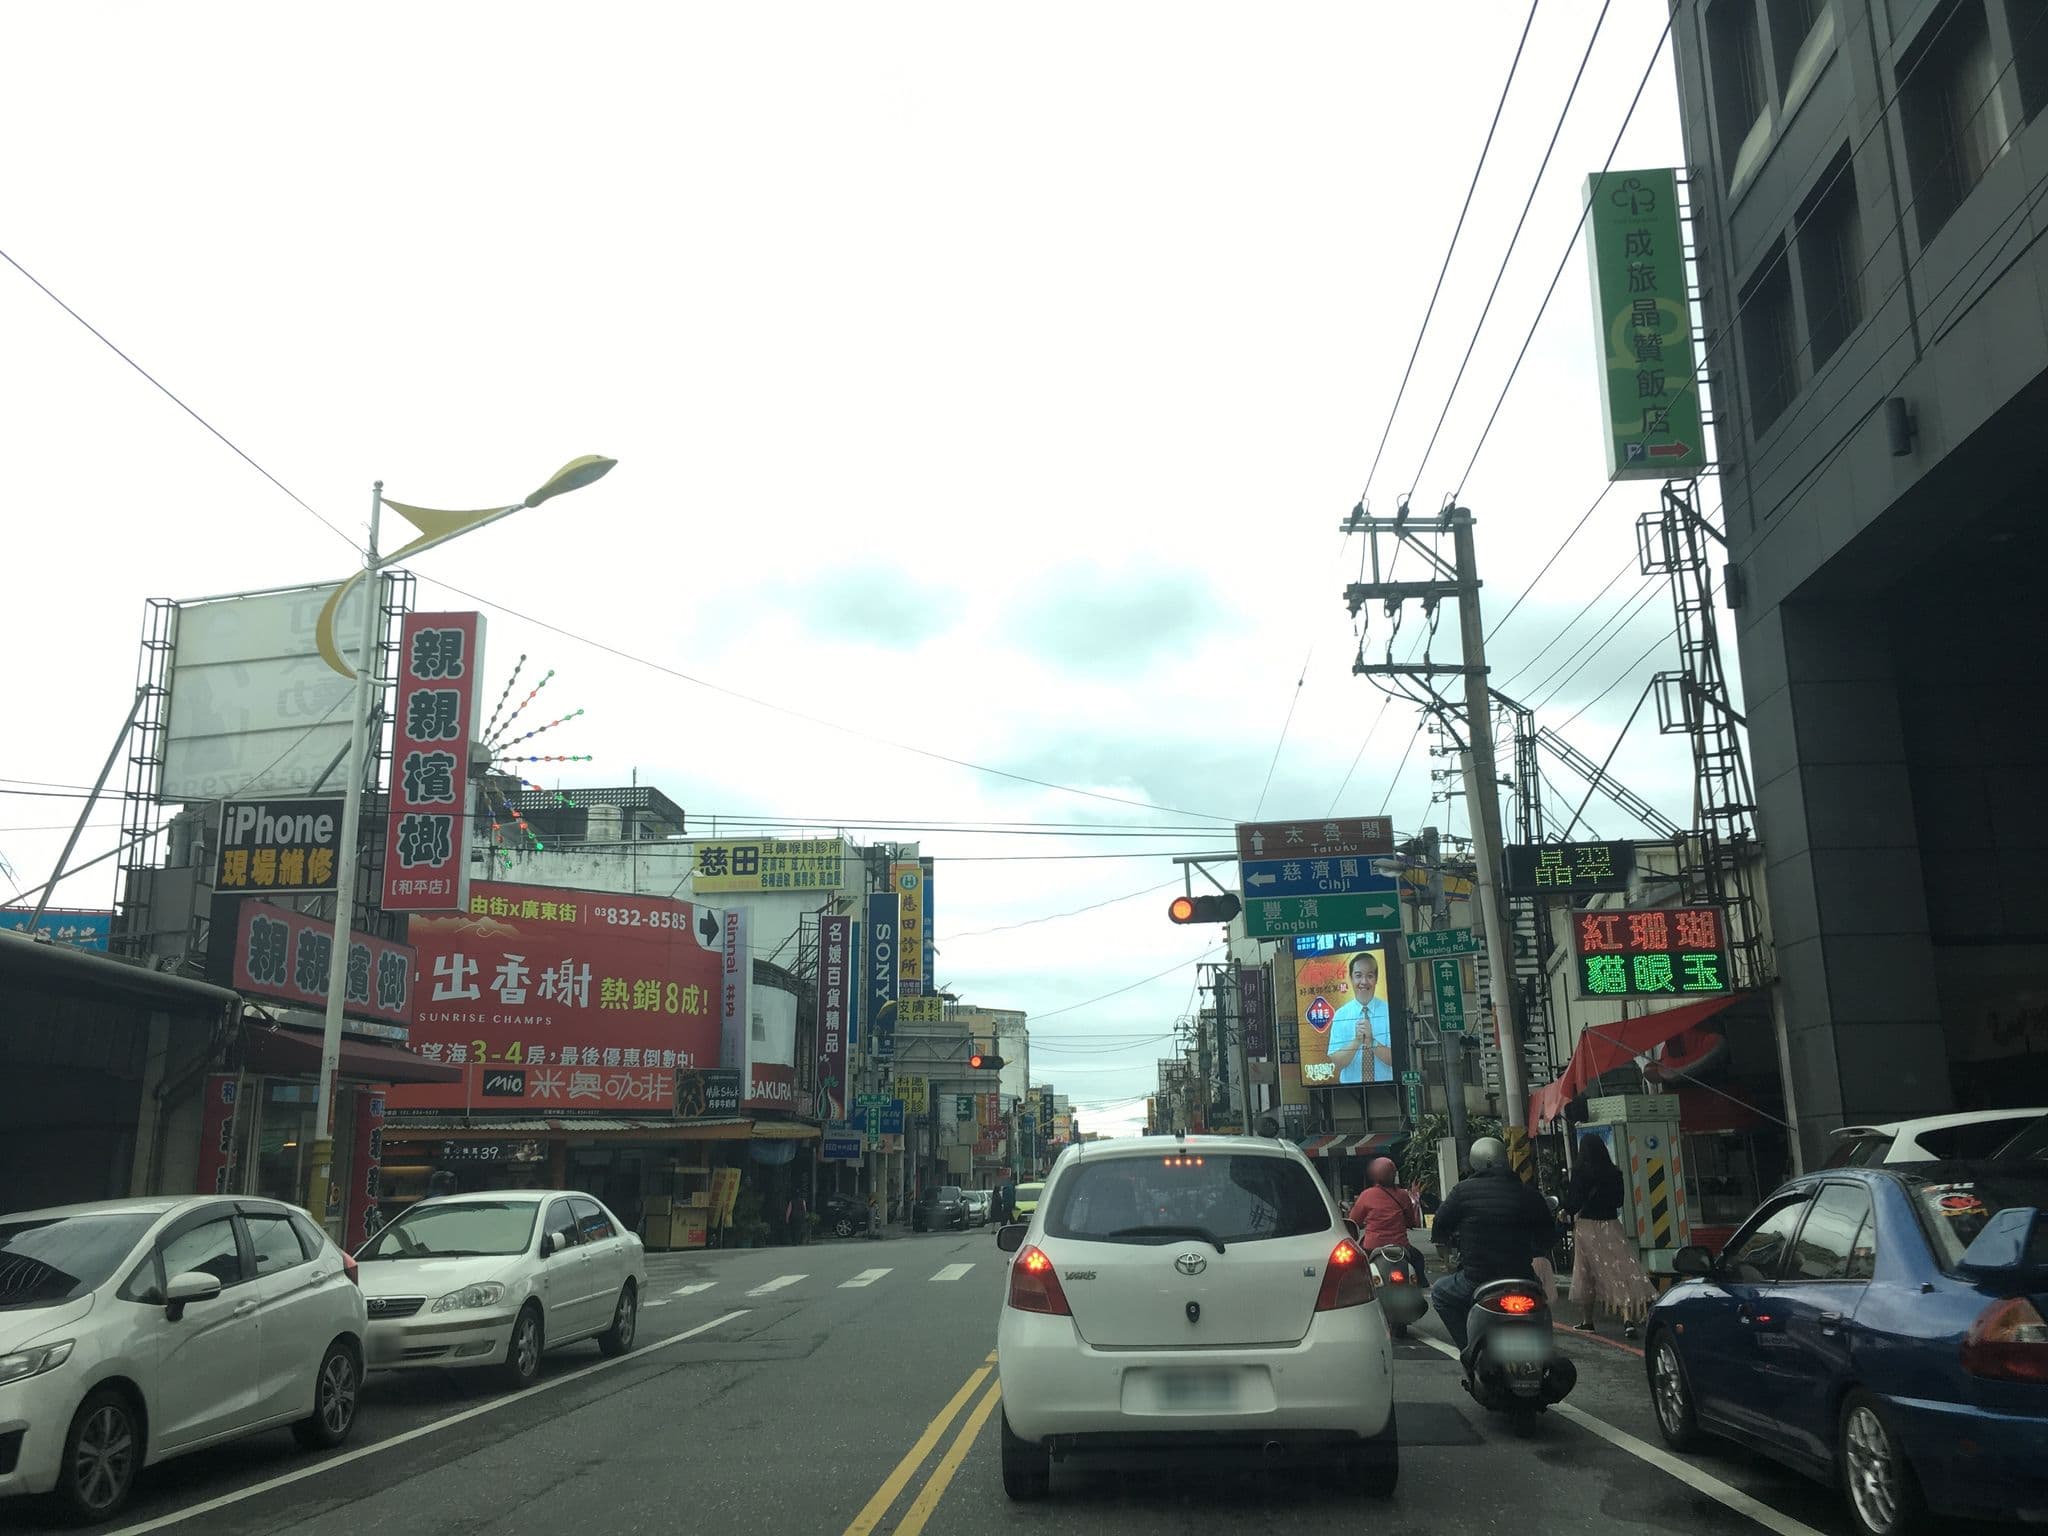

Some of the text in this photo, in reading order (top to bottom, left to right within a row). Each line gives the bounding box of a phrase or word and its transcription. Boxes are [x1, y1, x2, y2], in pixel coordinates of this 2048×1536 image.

[396, 627, 465, 869] 親親檳榔
[225, 806, 333, 847] iPhone
[1284, 821, 1380, 844] 太魯閣
[222, 848, 334, 887] 現場維修
[699, 846, 760, 876] 慈田
[1263, 899, 1319, 920] 豐濱
[1266, 920, 1318, 933] Fongbin
[727, 913, 739, 974] Rinnai
[1582, 911, 1717, 950] 紅珊瑚
[415, 953, 592, 1008] 出香榭
[875, 923, 891, 1002] SONY
[1586, 954, 1723, 994] 貓眼玉
[825, 923, 843, 1053] 名媛百貨精品
[419, 1013, 553, 1026] SUNRISE CHAMPS
[480, 1146, 499, 1160] 39
